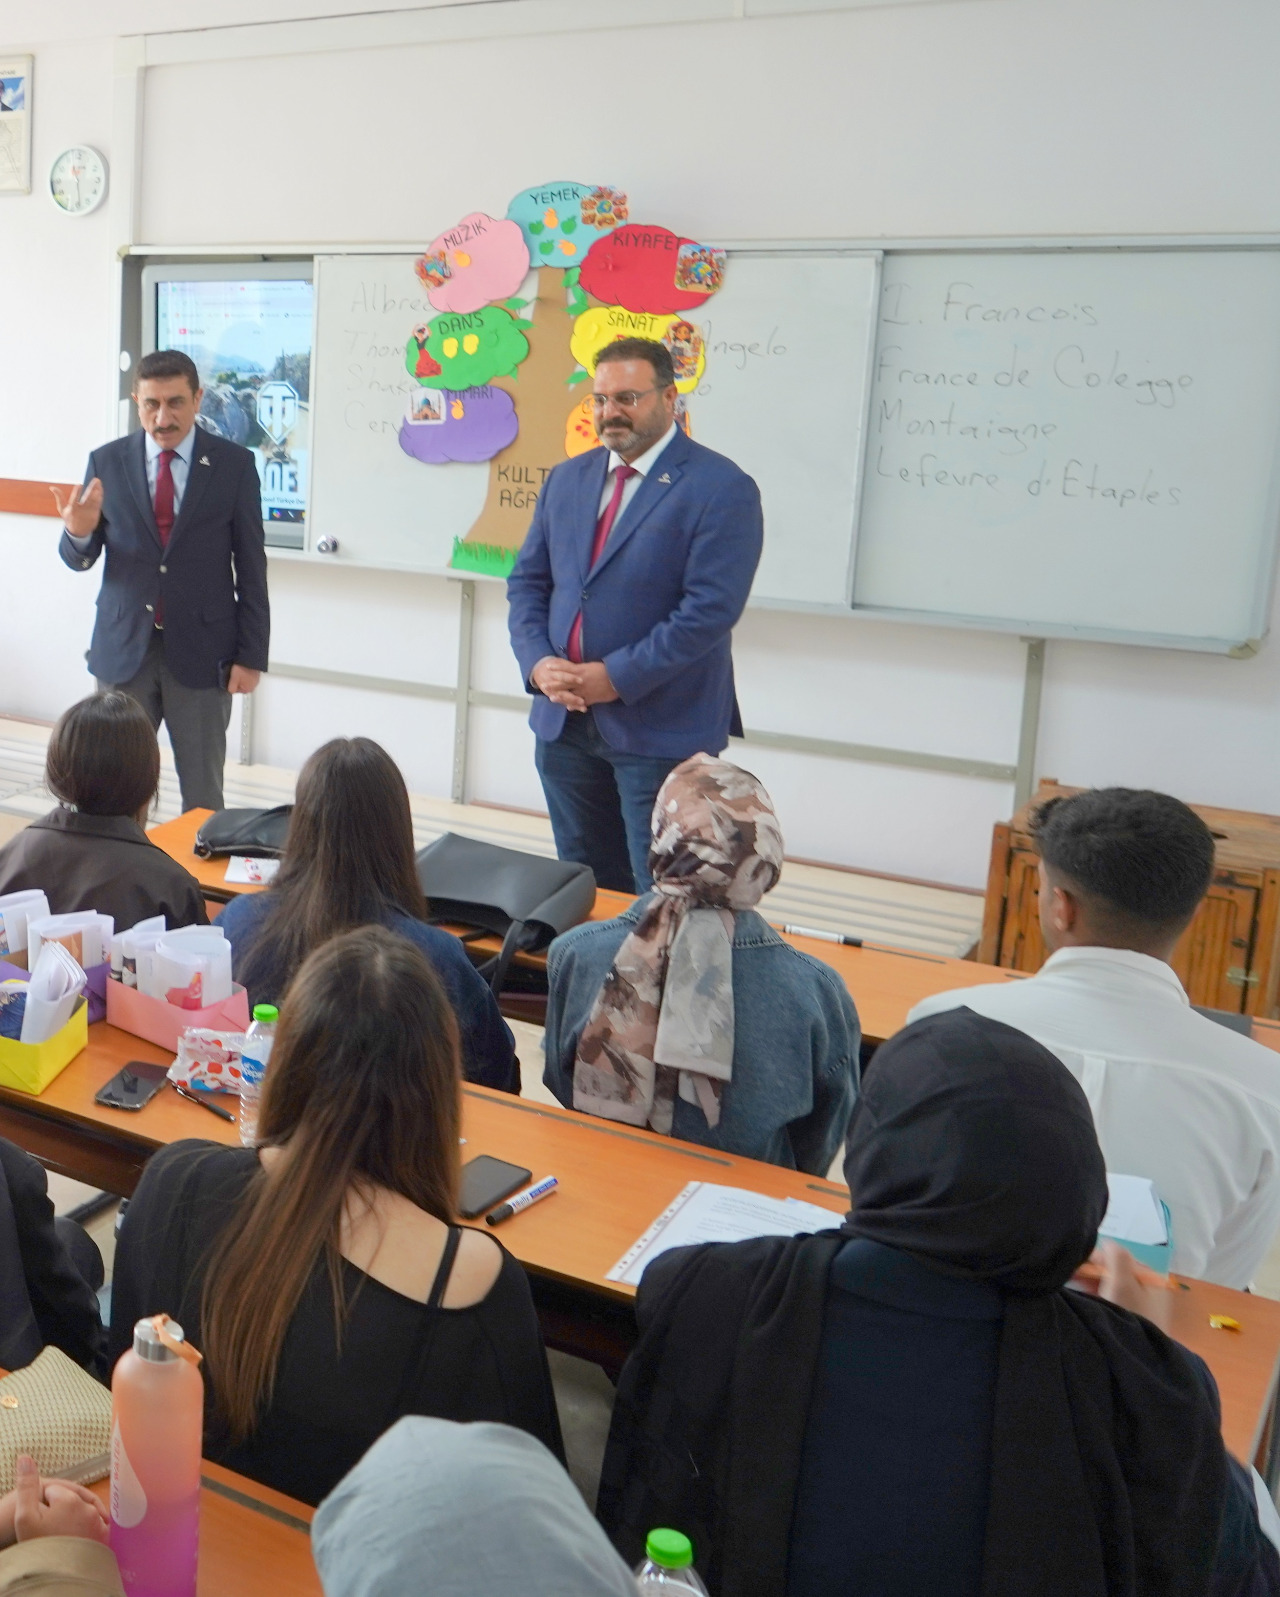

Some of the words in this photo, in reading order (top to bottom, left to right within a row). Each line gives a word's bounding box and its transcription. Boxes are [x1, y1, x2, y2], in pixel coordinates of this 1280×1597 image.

[529, 187, 581, 206] YEMEK
[350, 281, 433, 314] Albrec
[943, 281, 1099, 327] Francois
[438, 311, 485, 336] DANS
[607, 310, 659, 333] SANAT
[344, 329, 407, 358] Thom
[876, 344, 980, 387] France
[993, 343, 1031, 389] de
[877, 397, 1059, 456] Montaigne
[876, 445, 1000, 491] Lefevre
[499, 486, 539, 510] AĞA
